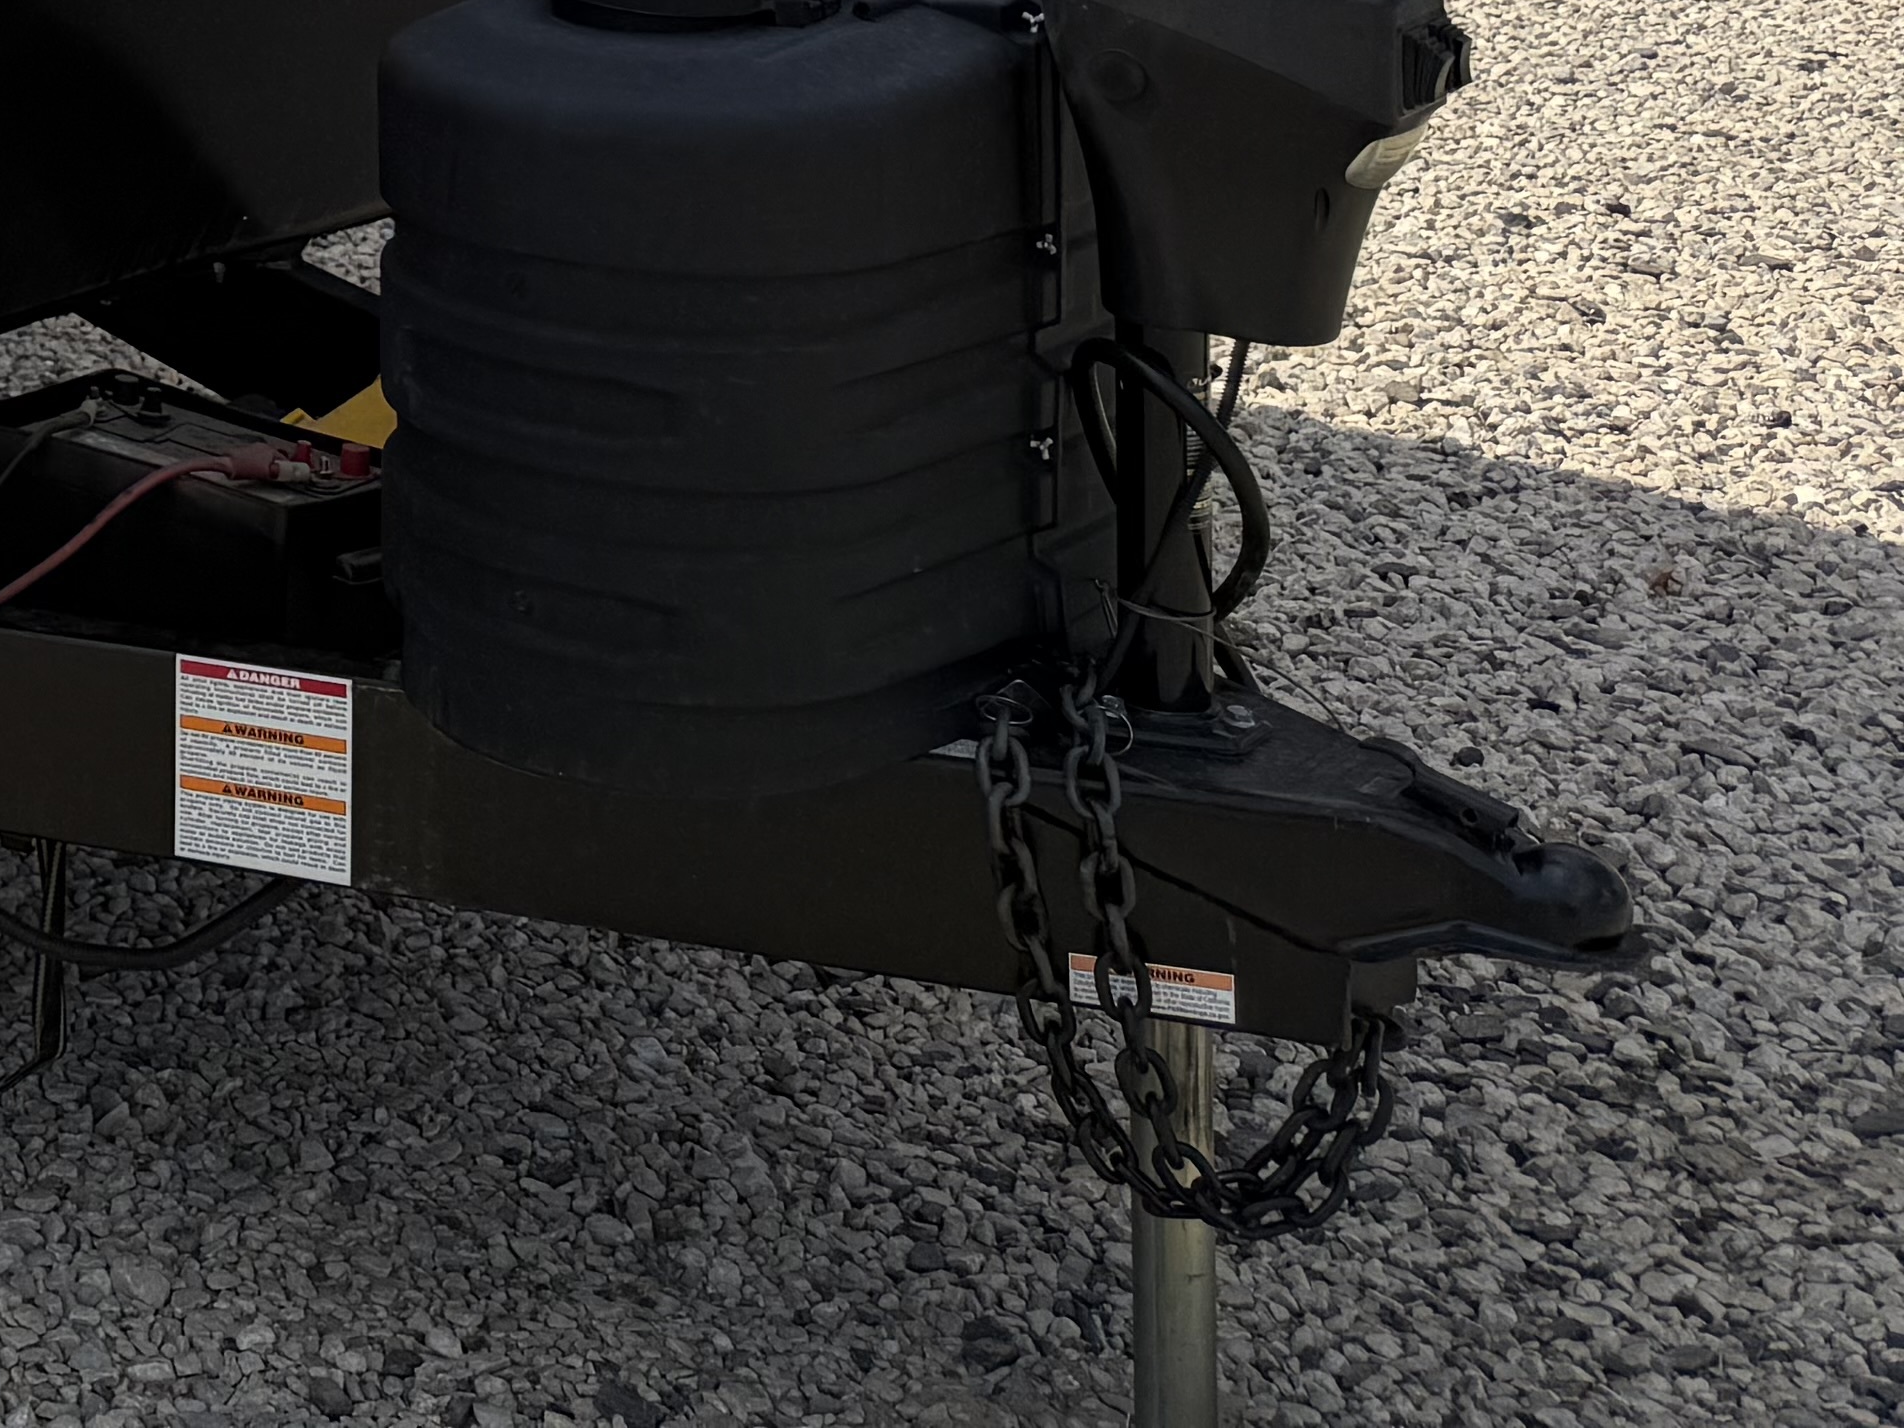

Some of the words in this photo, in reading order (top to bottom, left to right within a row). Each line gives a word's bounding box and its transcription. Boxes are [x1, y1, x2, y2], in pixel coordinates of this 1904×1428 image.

[239, 670, 302, 690] DANGER
[234, 725, 305, 745] WARNING
[234, 784, 305, 806] WARNING
[1148, 968, 1195, 984] RNING
